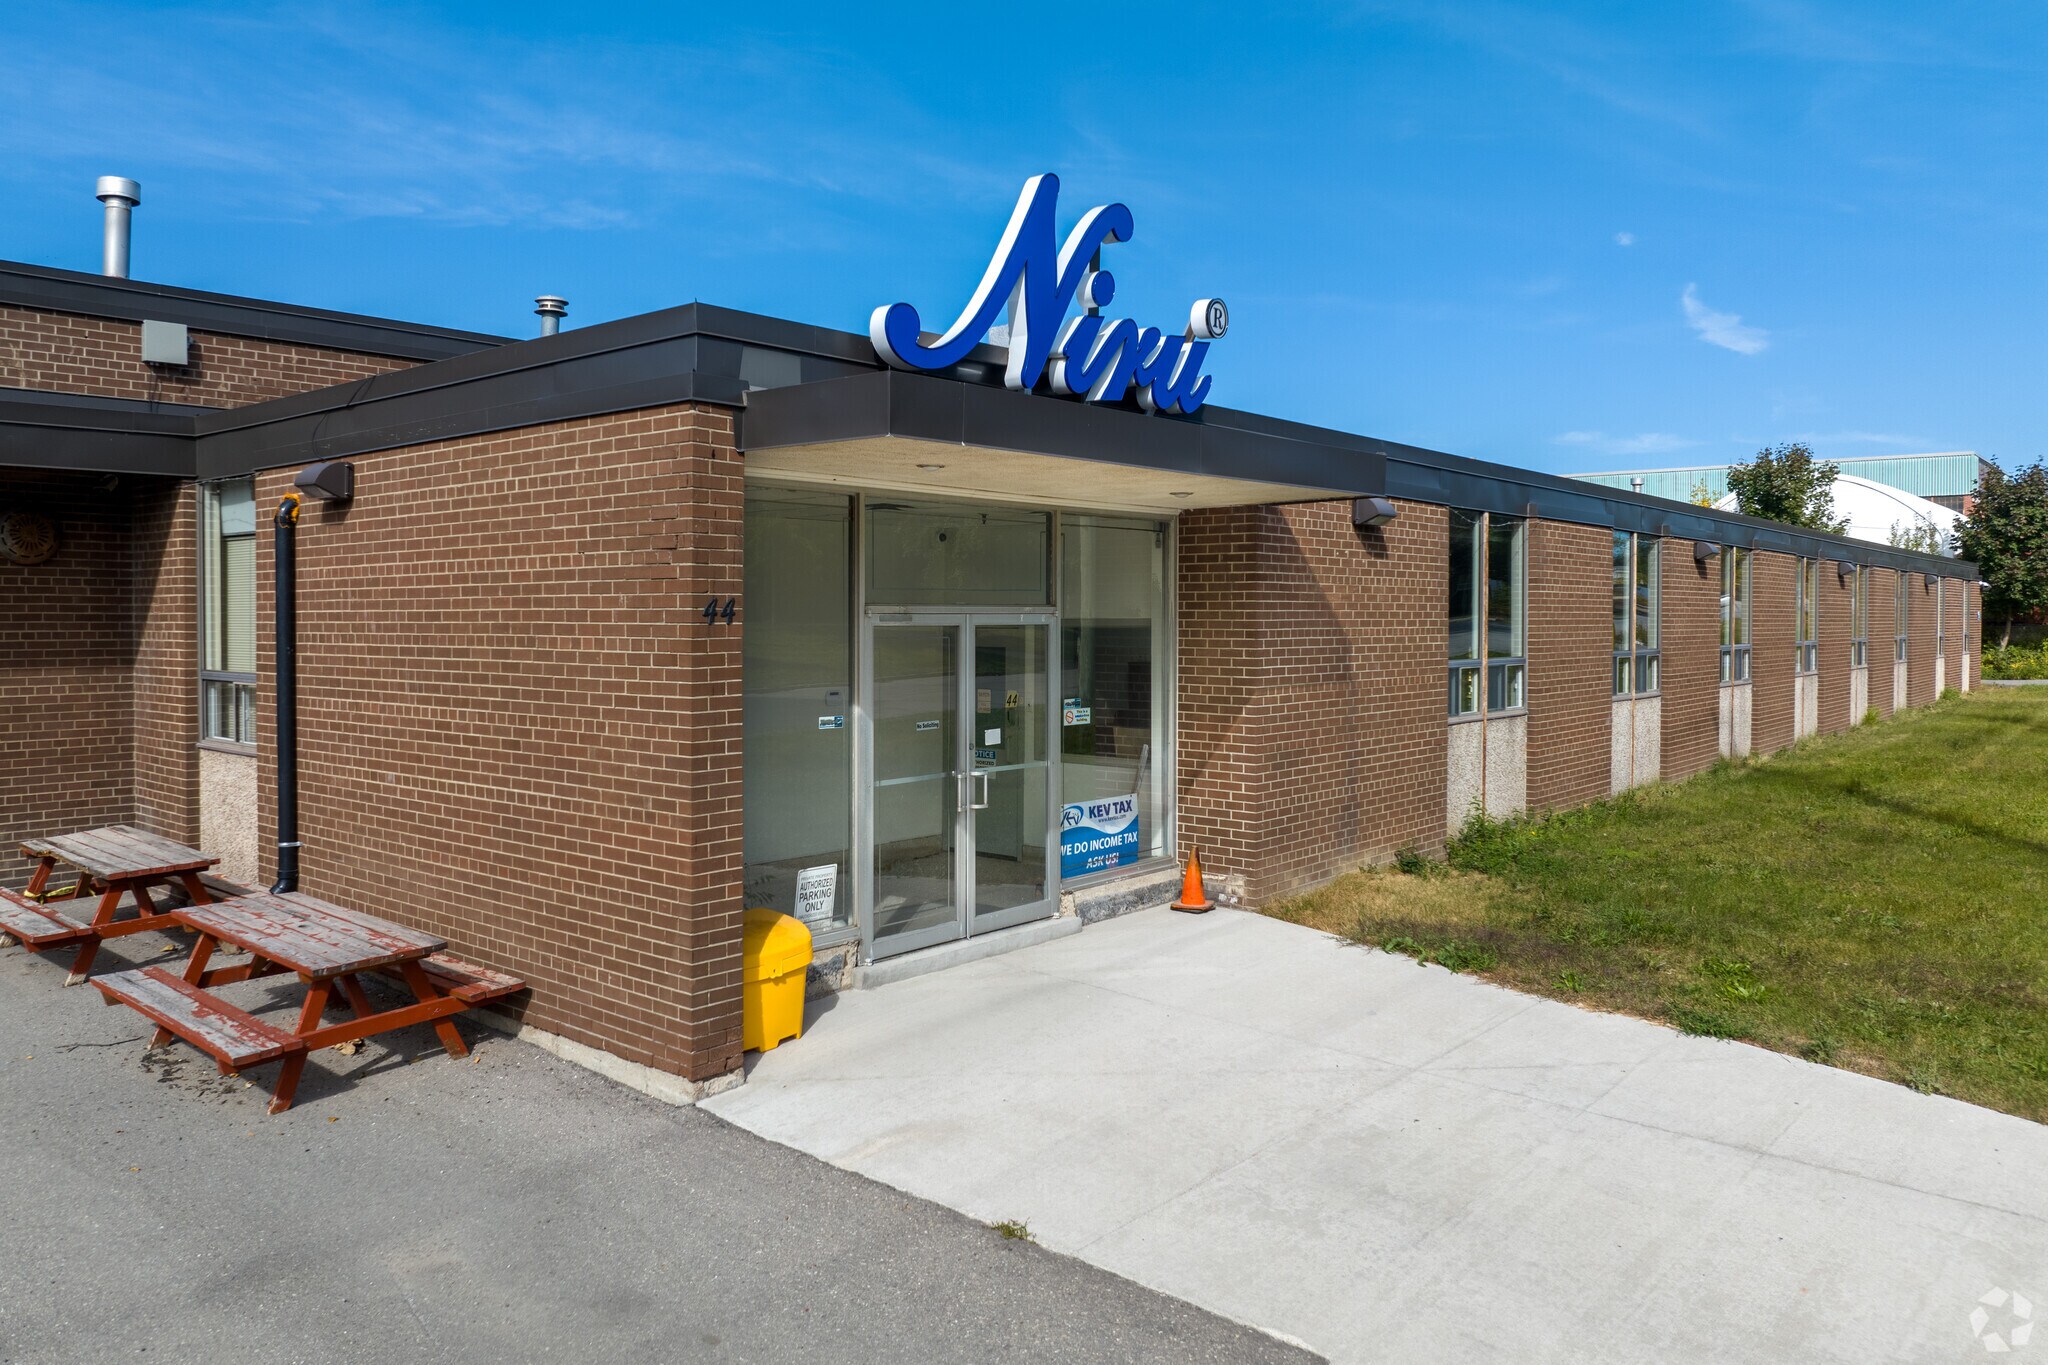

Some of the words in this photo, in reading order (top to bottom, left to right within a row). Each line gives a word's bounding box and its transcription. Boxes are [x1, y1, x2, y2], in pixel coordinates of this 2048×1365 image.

[703, 597, 736, 625] 44
[1007, 694, 1017, 706] 44
[975, 751, 994, 759] OTICE
[1088, 803, 1111, 819] KEV
[1113, 800, 1133, 814] TAX
[1074, 841, 1088, 854] DO
[1090, 835, 1123, 851] INCOME
[1124, 831, 1138, 844] TAX
[1086, 856, 1104, 869] ASK
[1105, 852, 1119, 864] US!
[800, 878, 833, 892] AUTHORIZED
[799, 887, 832, 903] PARKING
[805, 900, 825, 912] ONLY
